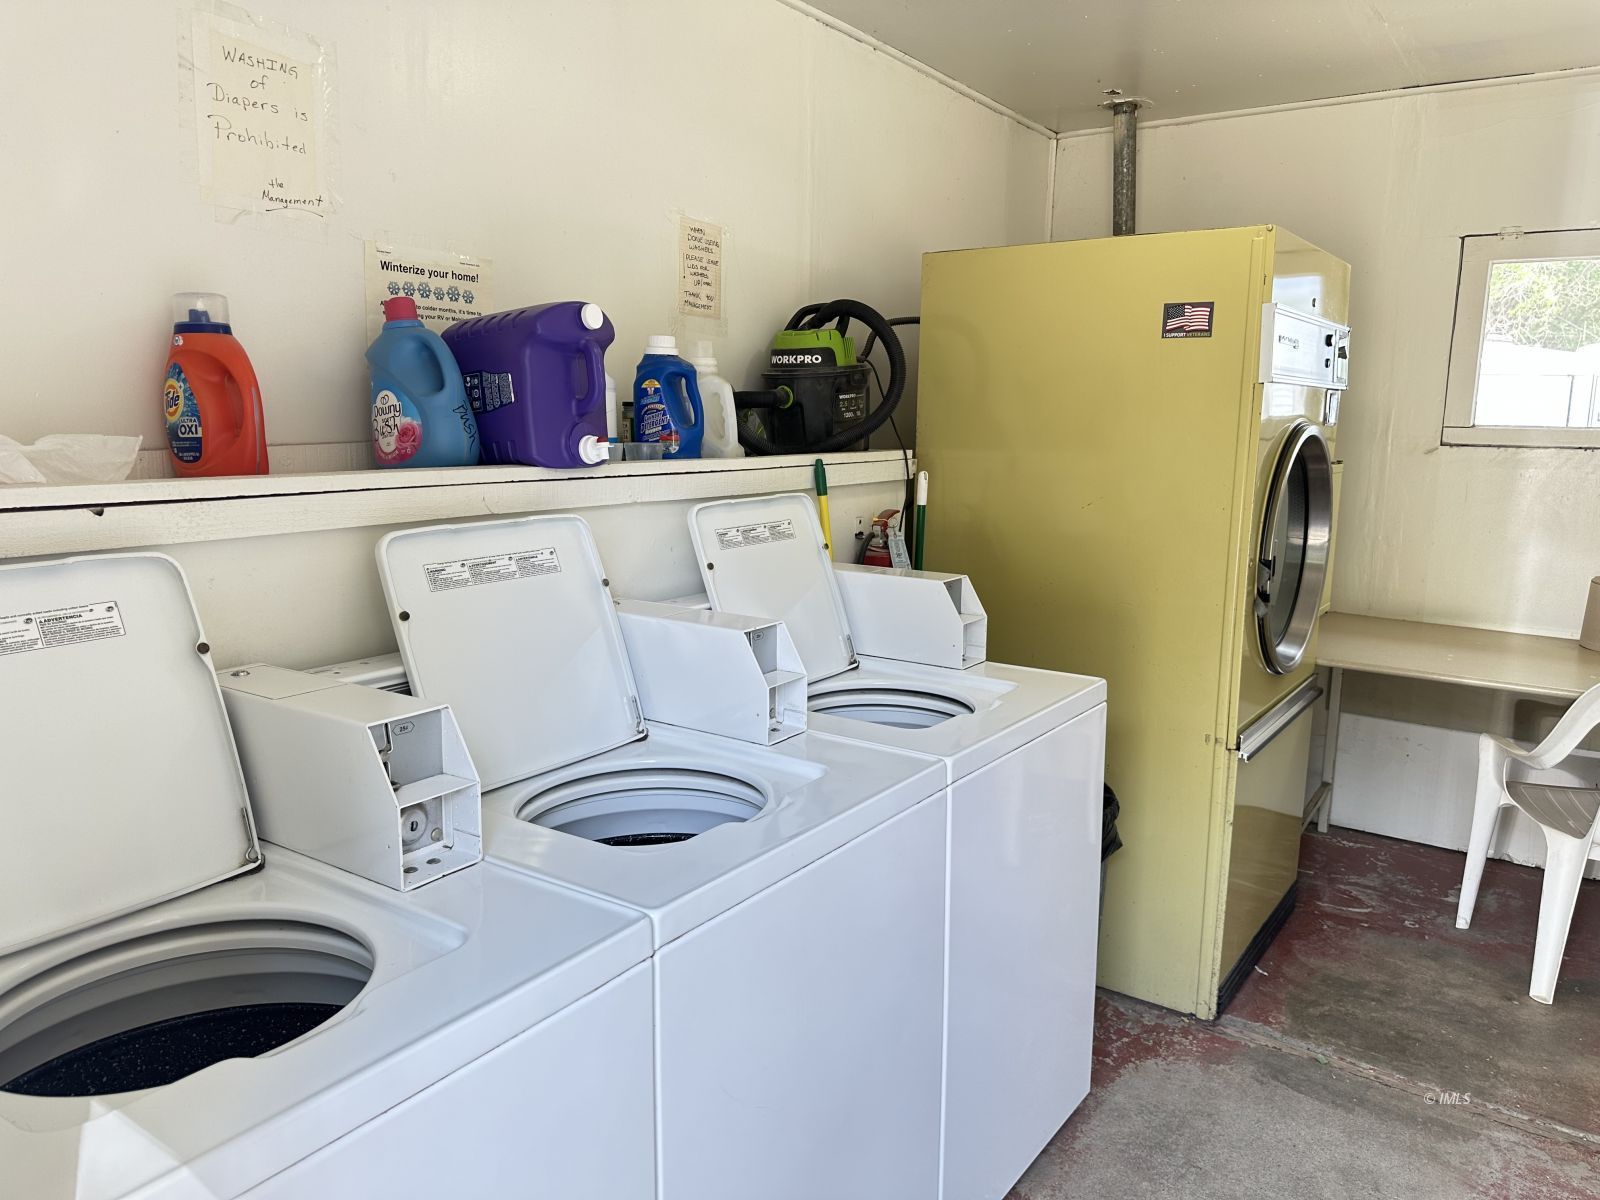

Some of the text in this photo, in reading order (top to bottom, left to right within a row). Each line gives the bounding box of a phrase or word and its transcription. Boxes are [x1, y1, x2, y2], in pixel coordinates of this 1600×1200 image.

[222, 45, 297, 79] WASHING
[250, 75, 269, 89] of
[206, 82, 308, 121] Diapers is
[207, 114, 307, 154] Prohibited
[268, 177, 284, 189] the
[261, 189, 324, 208] Management
[685, 253, 704, 263] PLEASE
[380, 260, 479, 283] Winterize your home!
[684, 299, 713, 310] MANAGEMENT
[771, 354, 822, 364] WORKPRO
[164, 390, 180, 411] Tide
[373, 402, 402, 418] Downy
[179, 423, 199, 436] OXI
[43, 613, 83, 623] ADVERTENCIA
